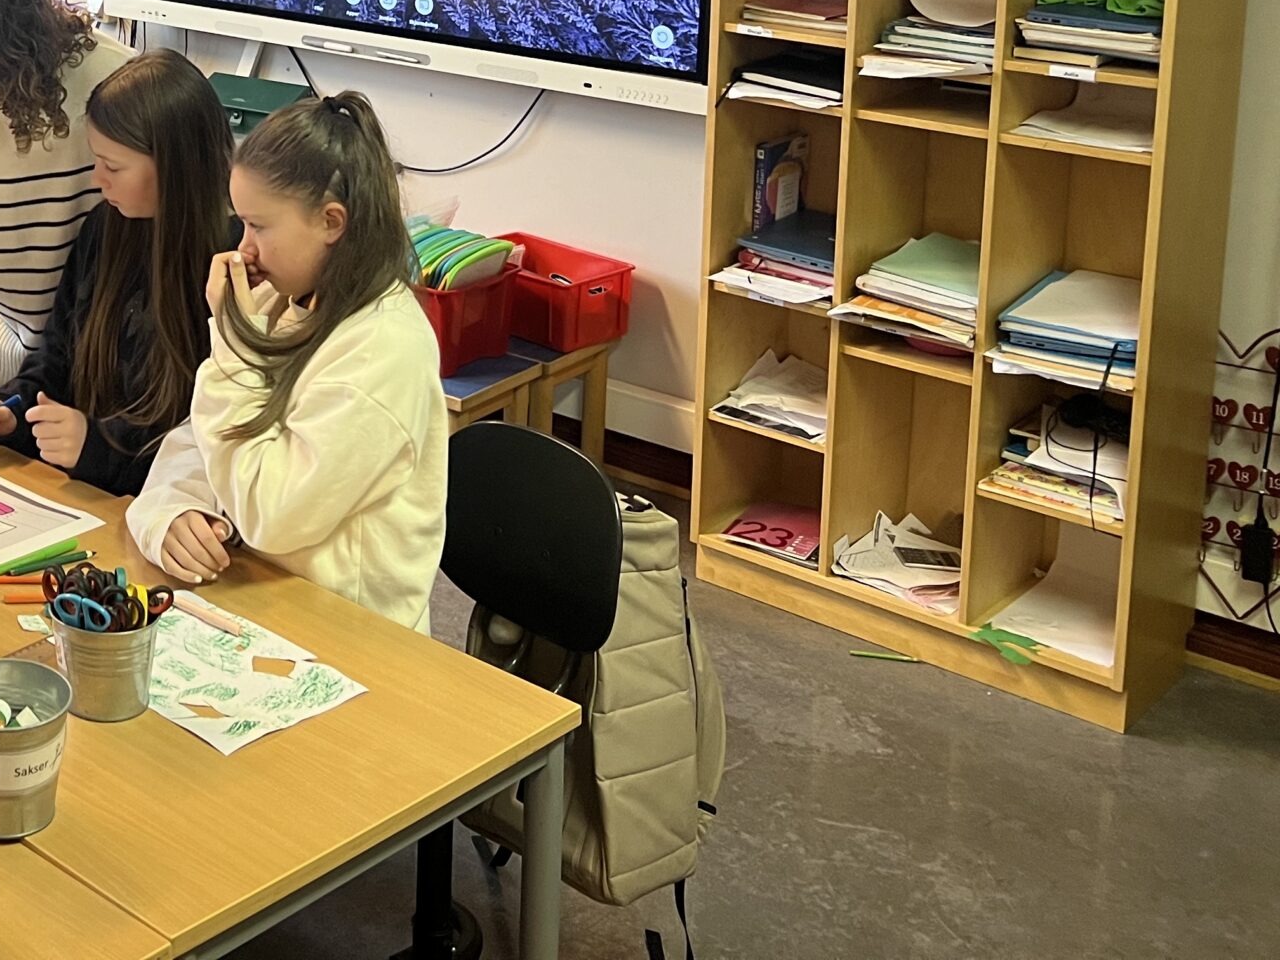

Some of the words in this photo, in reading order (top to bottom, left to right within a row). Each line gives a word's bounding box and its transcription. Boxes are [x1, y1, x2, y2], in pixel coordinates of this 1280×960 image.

[1215, 404, 1228, 417] 10
[1251, 411, 1265, 425] 11
[1235, 470, 1249, 483] 18
[14, 759, 49, 778] Sakser
